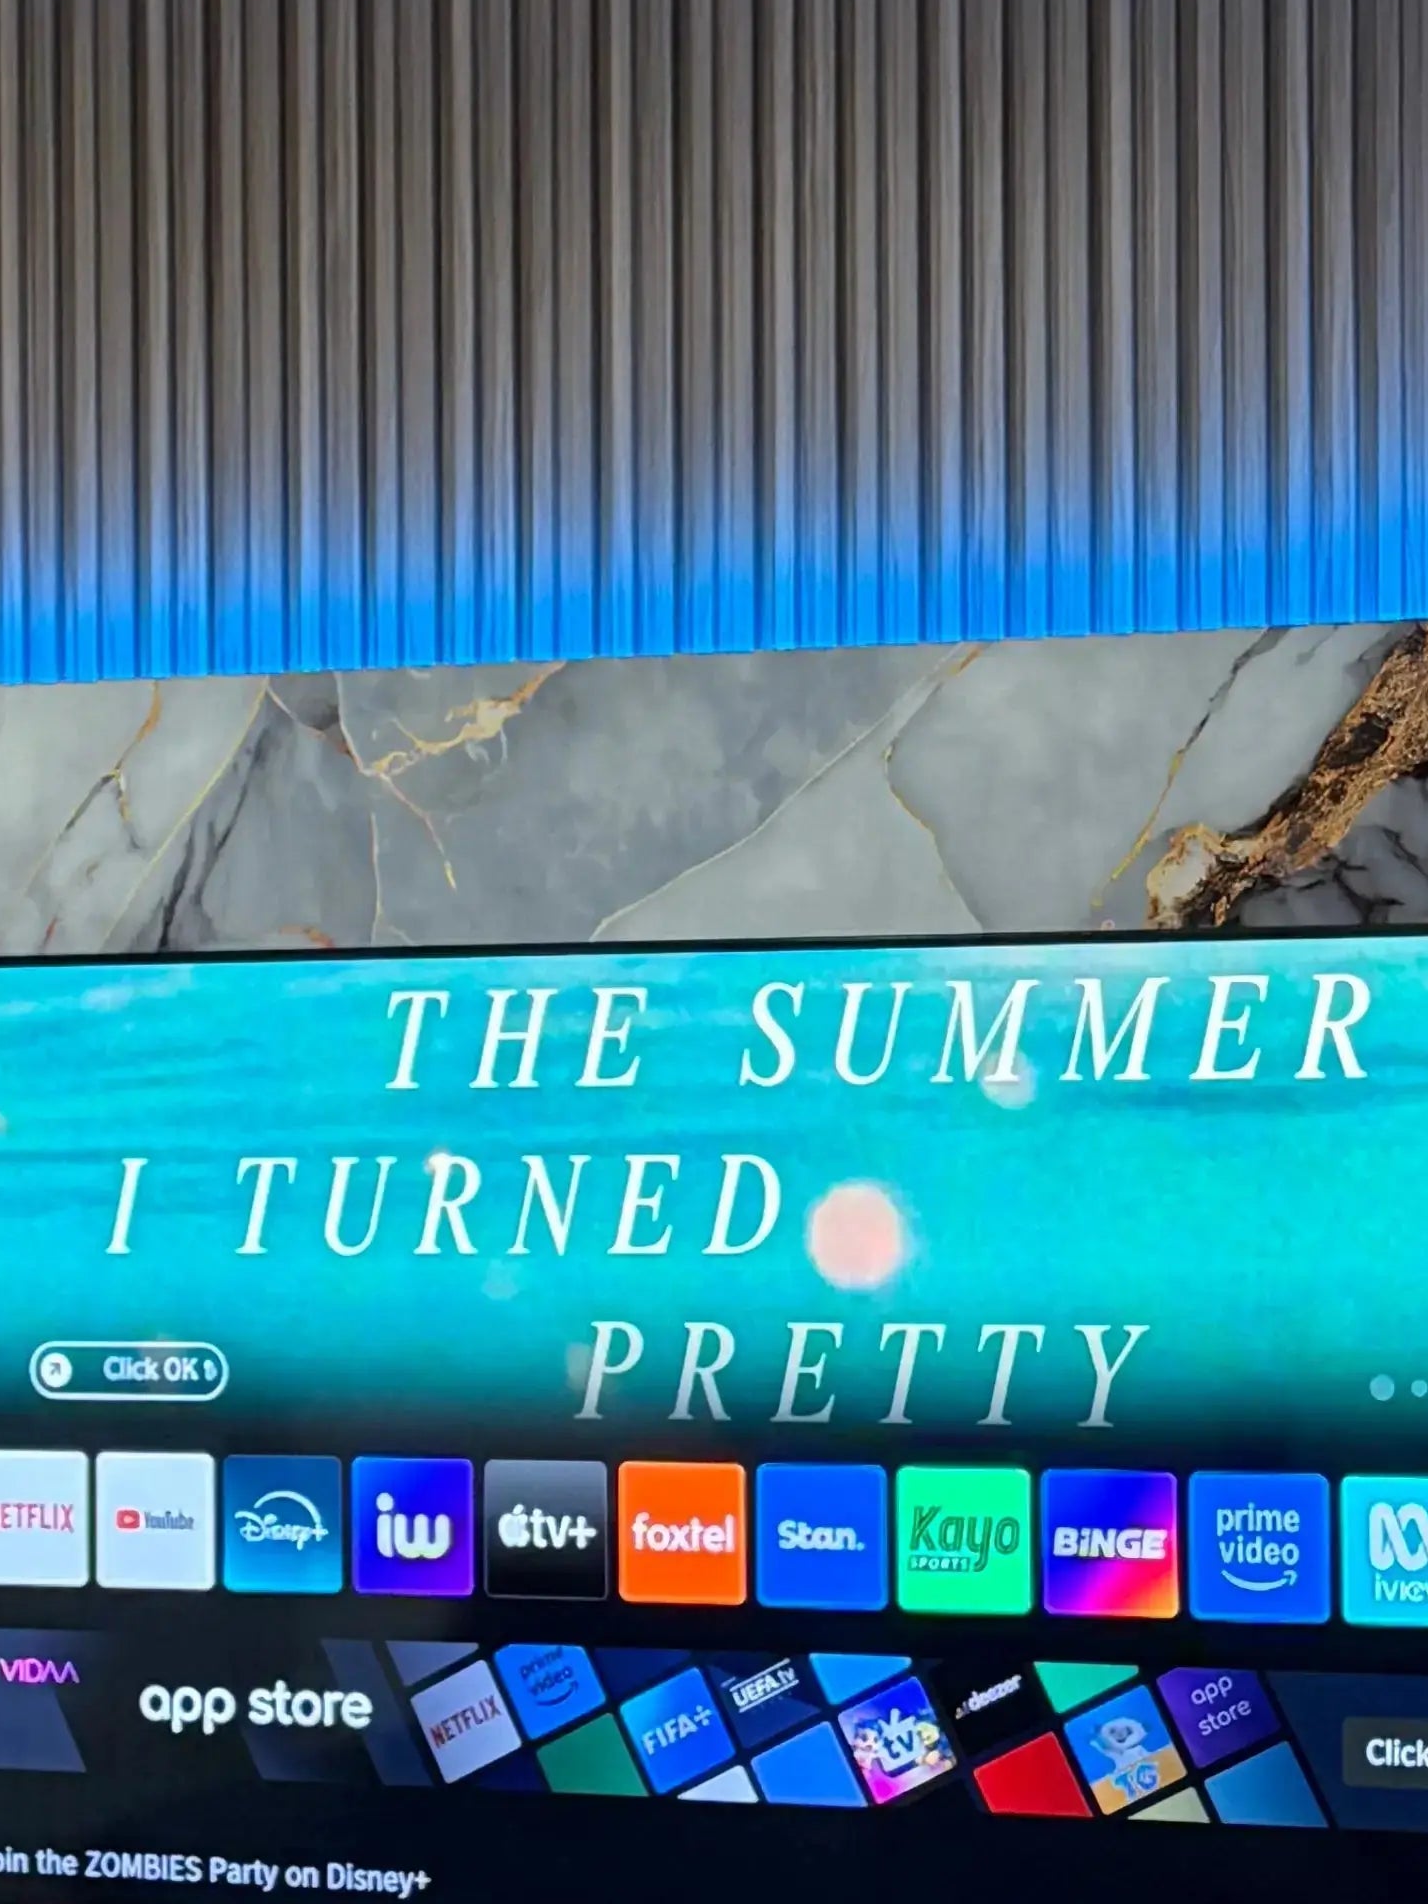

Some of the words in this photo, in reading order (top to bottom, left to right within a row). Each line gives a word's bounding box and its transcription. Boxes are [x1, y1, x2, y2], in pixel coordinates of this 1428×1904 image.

[386, 987, 647, 1091] THE
[739, 972, 1373, 1089] SUMMER
[105, 1157, 150, 1255] I
[234, 1153, 783, 1257] TURNED
[103, 1355, 160, 1382] Click
[163, 1356, 200, 1382] OK
[573, 1320, 1152, 1430] PRETTY
[144, 1510, 195, 1530] YouTube
[632, 1512, 735, 1553] foxtel
[777, 1519, 866, 1551] Stan.
[1217, 1502, 1300, 1536] prime
[910, 1505, 1020, 1572] Kayo
[1219, 1535, 1300, 1565] video
[0, 1657, 80, 1684] VIDAA
[527, 1665, 573, 1696] video
[139, 1684, 236, 1735] app
[247, 1679, 373, 1730] store
[1191, 1676, 1233, 1704] app
[430, 1695, 502, 1748] NETFLIX
[1198, 1700, 1252, 1736] store
[883, 1730, 914, 1760] tv
[36, 1848, 77, 1876] the
[85, 1849, 202, 1883] ZOMBIES
[210, 1856, 278, 1892] Party
[285, 1865, 319, 1889] on
[327, 1862, 432, 1899] Disney+
